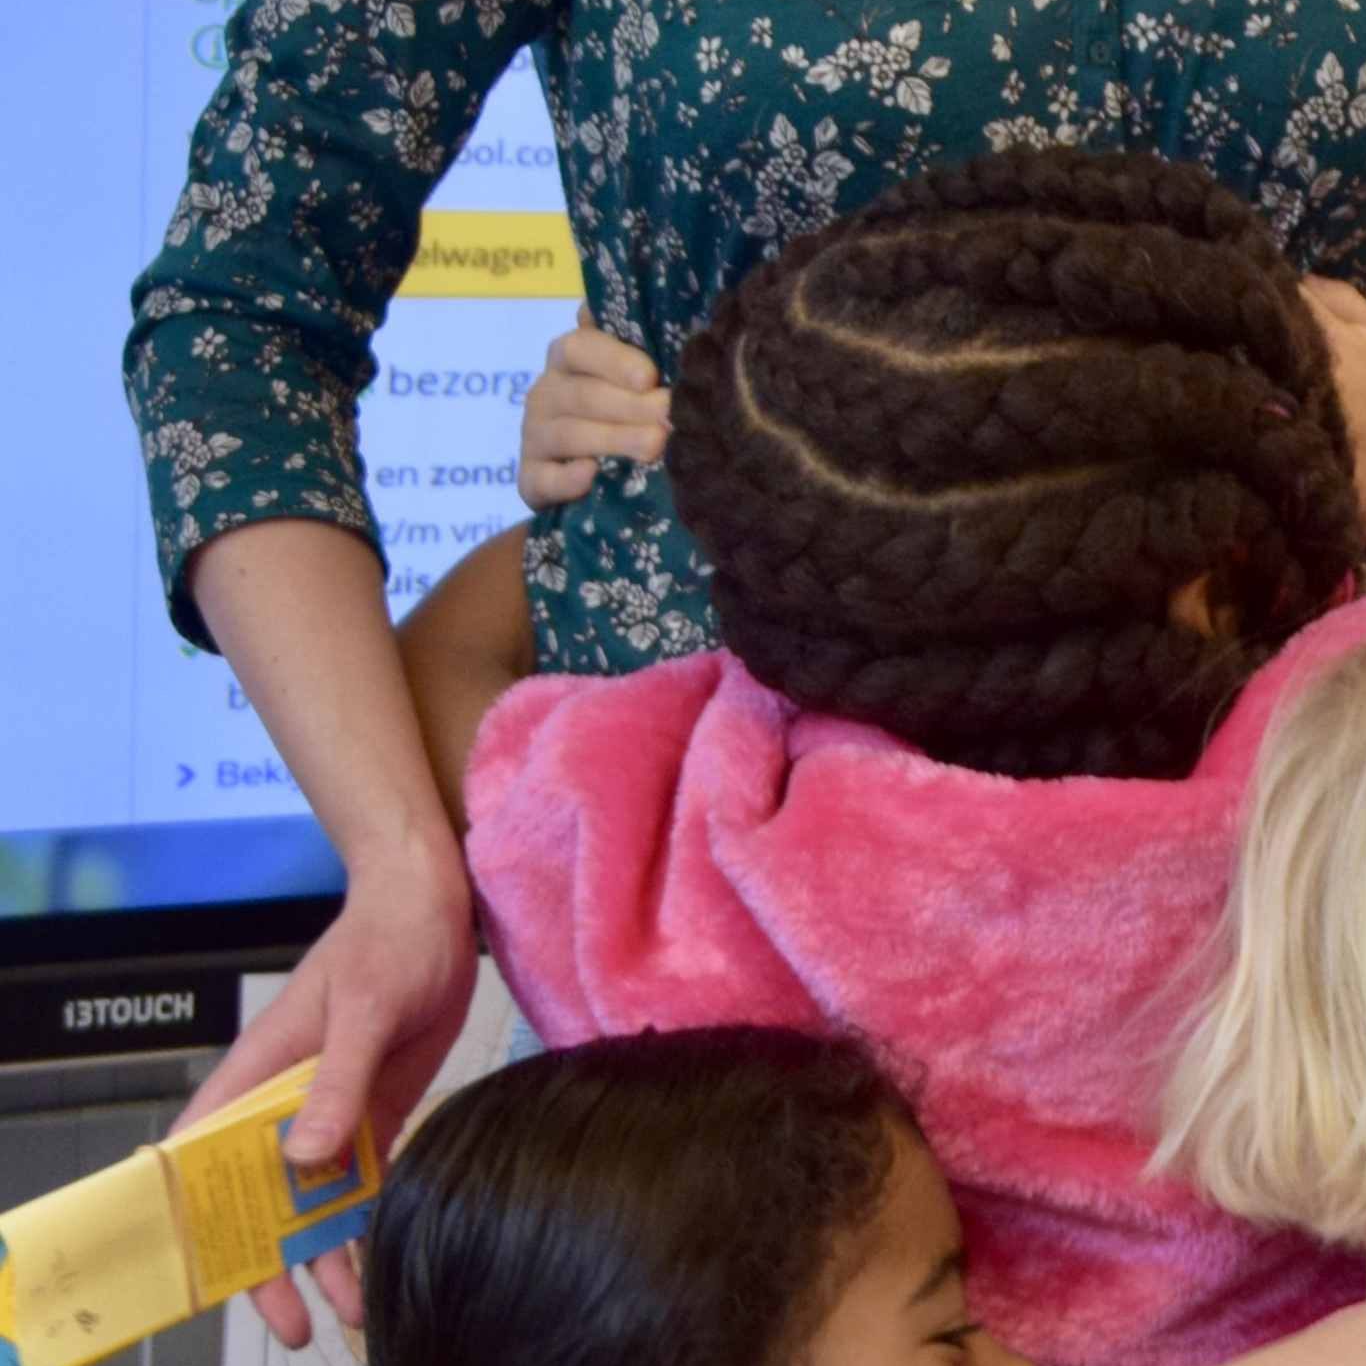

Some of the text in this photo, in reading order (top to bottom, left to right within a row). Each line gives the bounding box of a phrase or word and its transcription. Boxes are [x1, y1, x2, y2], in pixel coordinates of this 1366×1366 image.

[387, 366, 530, 405] bezorg
[375, 459, 517, 486] en zond
[63, 990, 195, 1029] i3TOUCH
